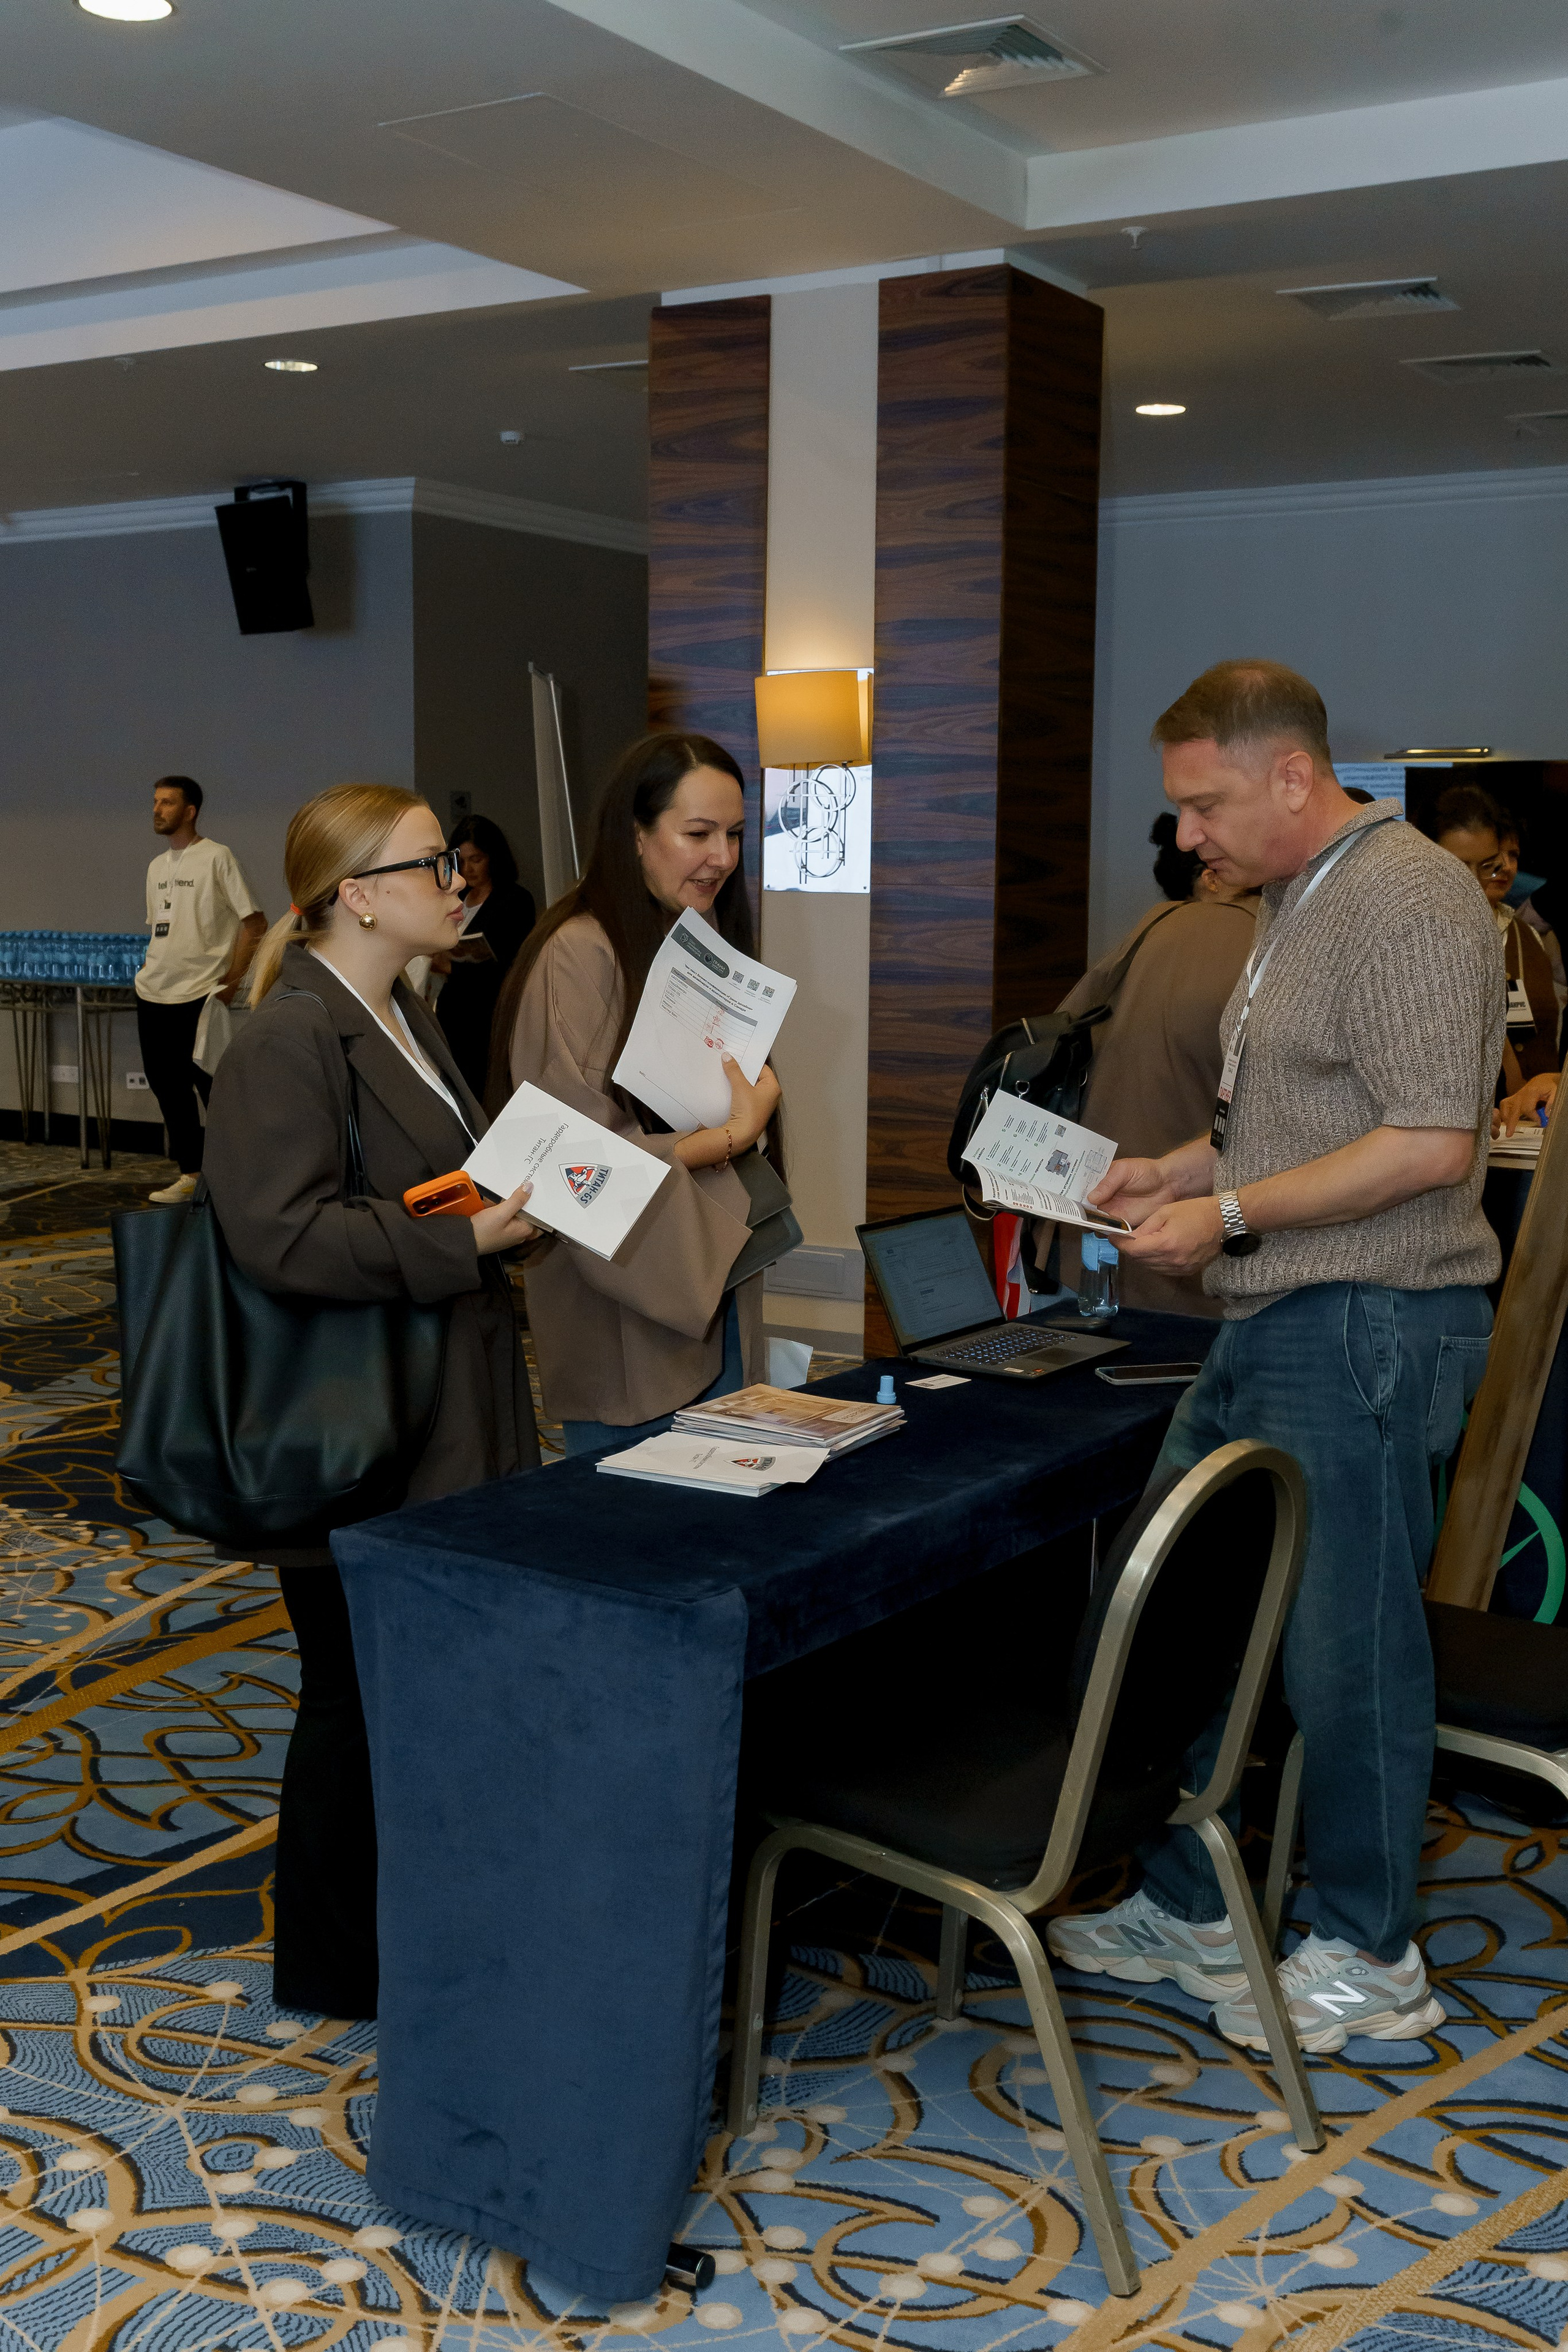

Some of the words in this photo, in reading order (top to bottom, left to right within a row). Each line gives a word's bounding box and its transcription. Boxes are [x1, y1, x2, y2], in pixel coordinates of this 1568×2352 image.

[523, 1137, 546, 1164] Титан-ГС
[537, 1122, 569, 1164] Гардеробные
[1116, 1918, 1170, 1952] N
[1307, 1980, 1371, 2017] N
